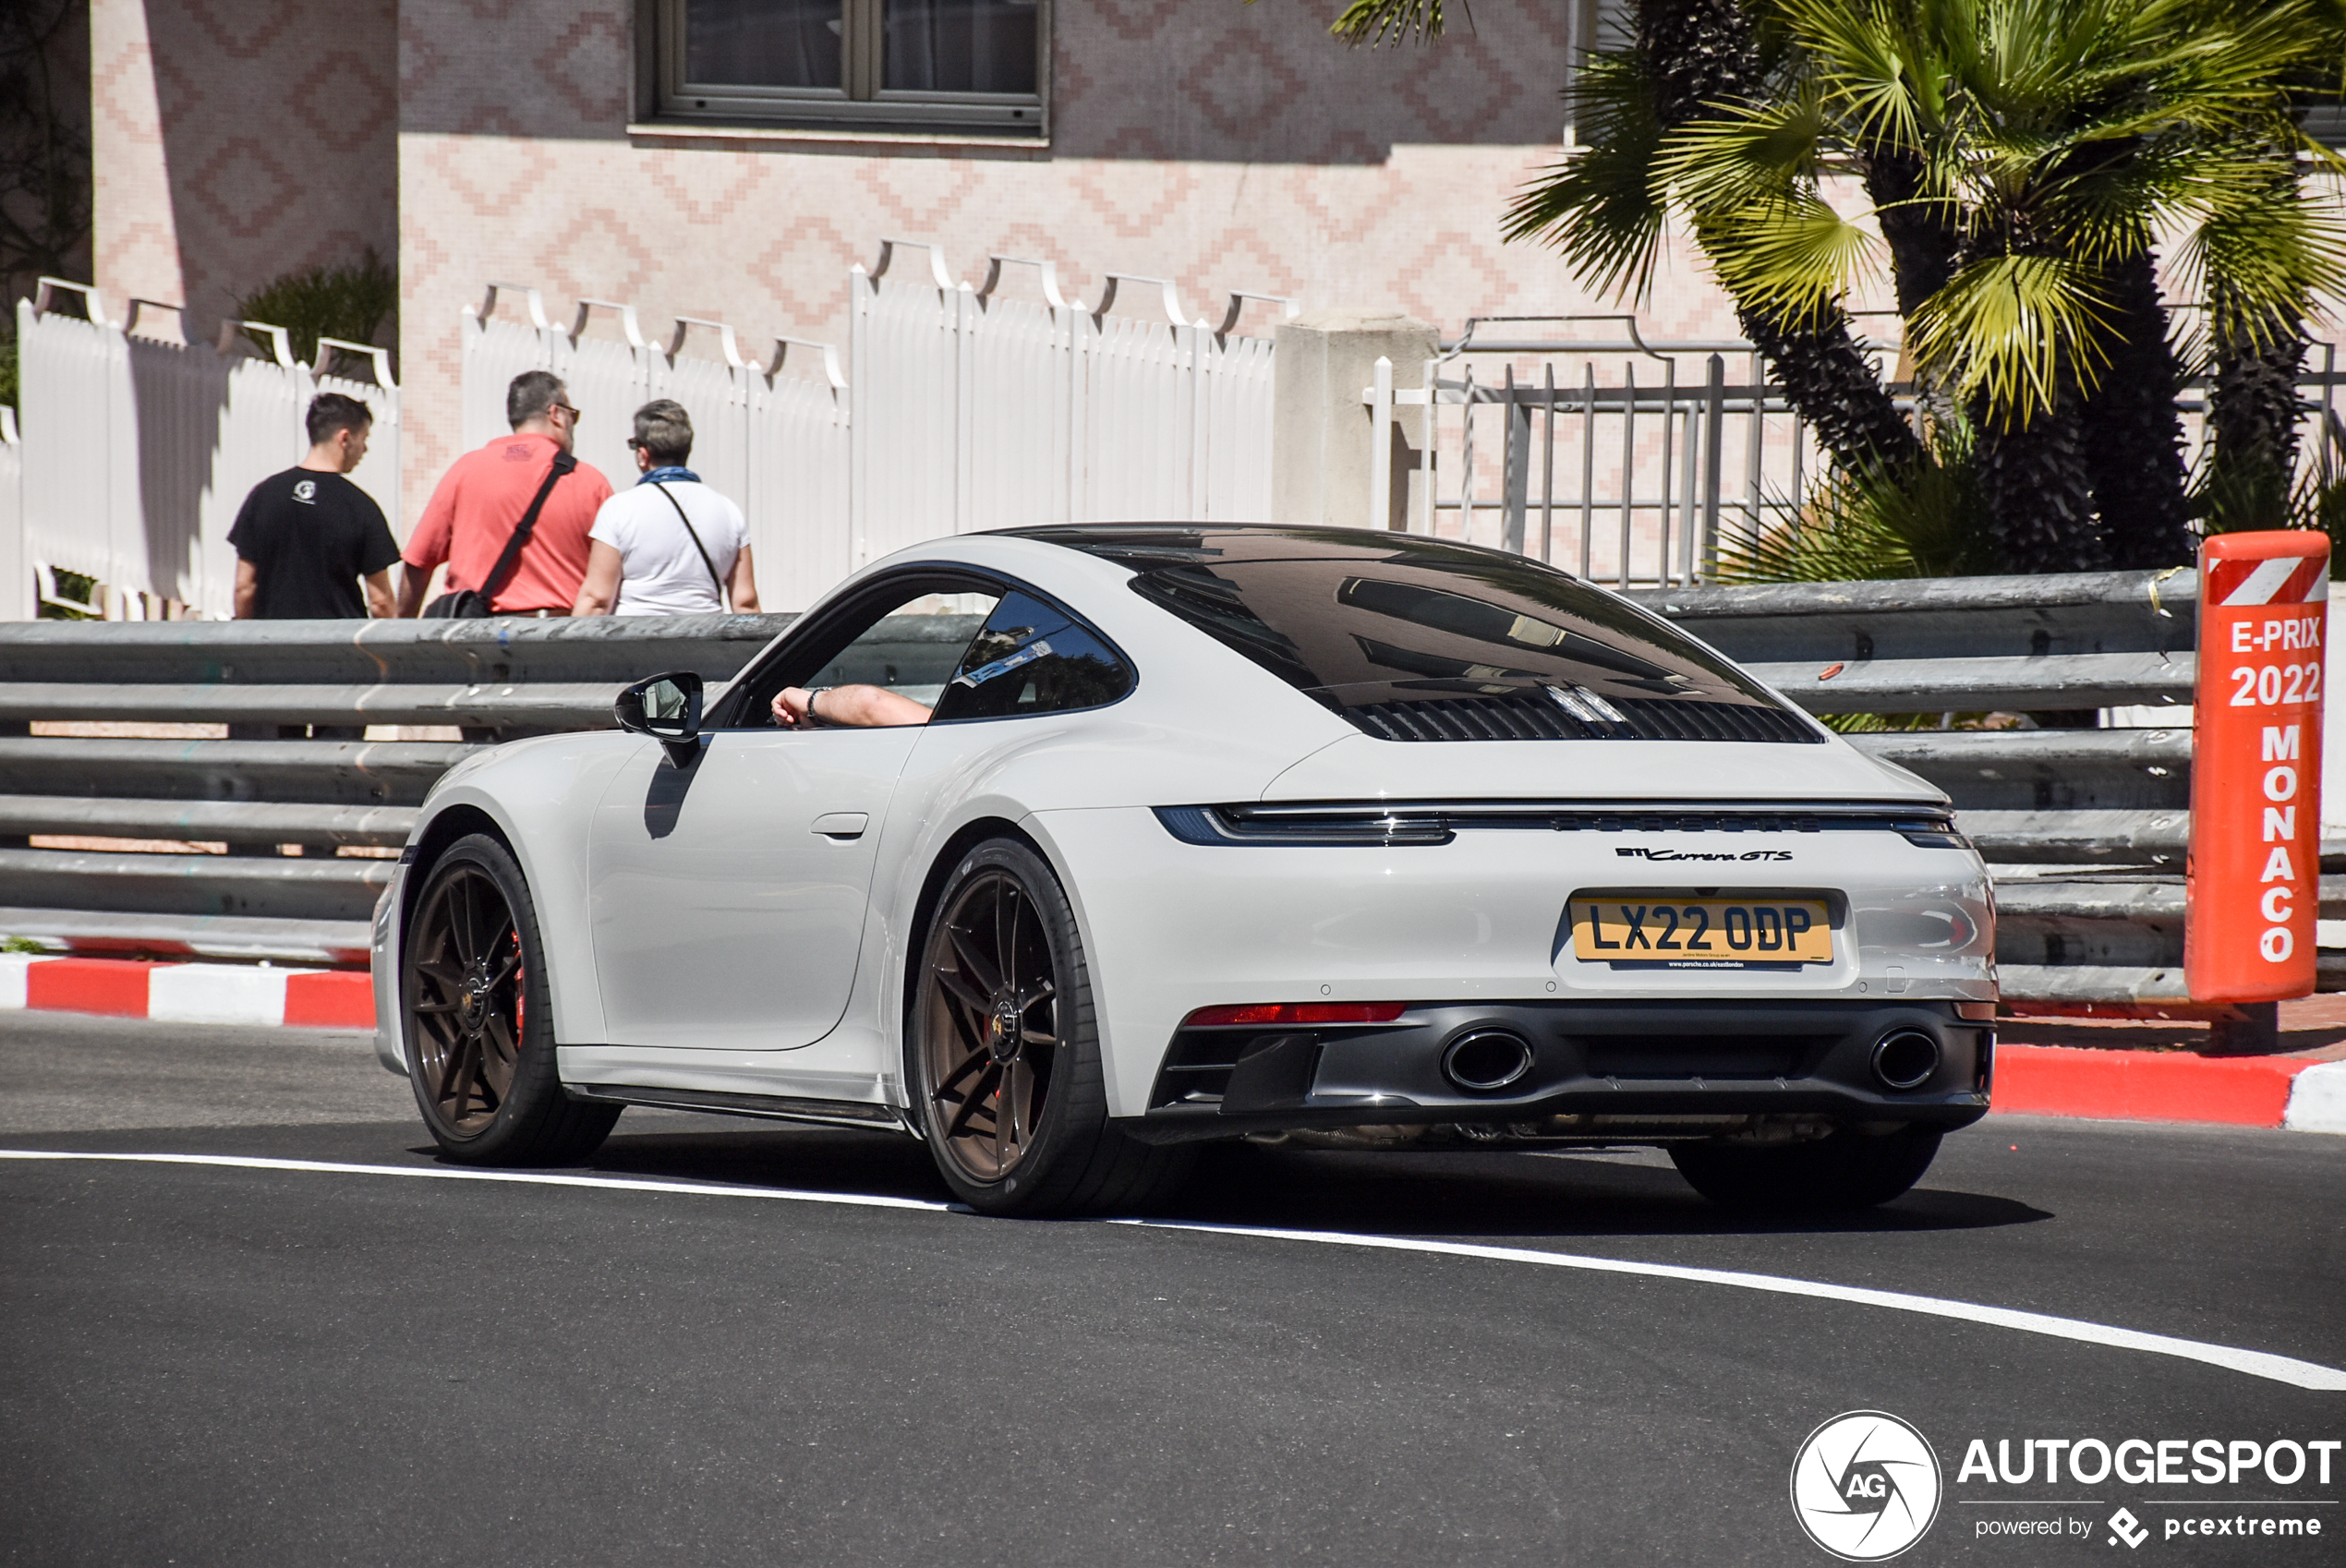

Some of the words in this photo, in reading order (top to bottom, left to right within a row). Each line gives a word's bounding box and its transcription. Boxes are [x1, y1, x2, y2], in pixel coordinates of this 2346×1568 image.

[2231, 617, 2321, 653] E-PRIX
[2230, 661, 2321, 707] 2022
[1554, 817, 1820, 832] PORSCHE
[2260, 725, 2300, 962] MONACO
[1647, 850, 1737, 862] Carrera
[1739, 850, 1794, 862] GTS
[1590, 905, 1712, 950] LX22
